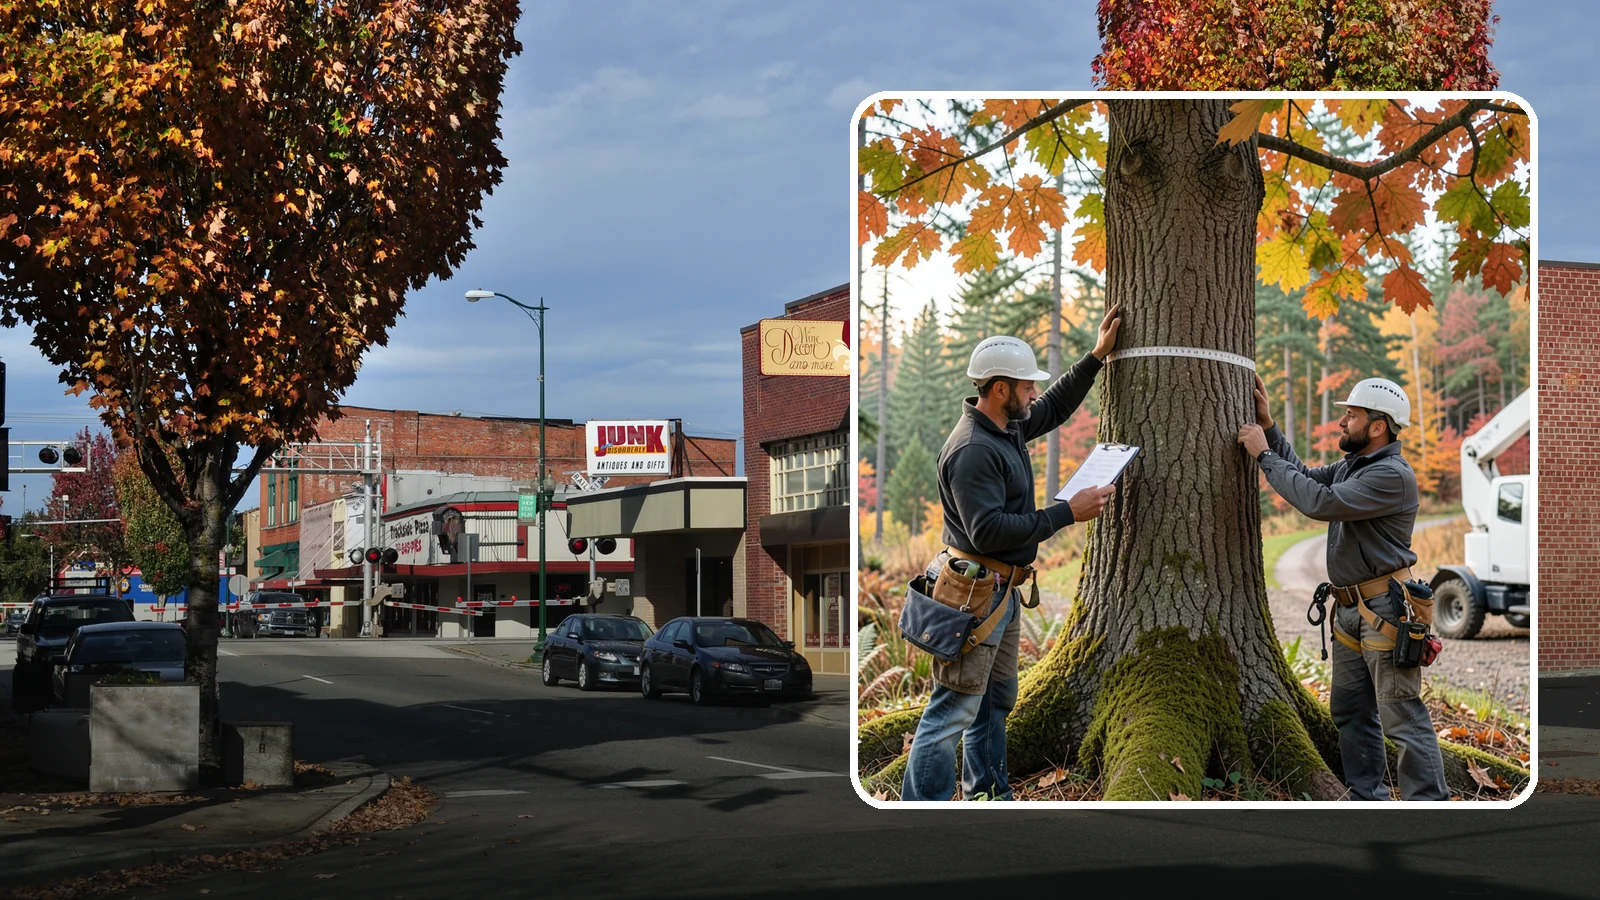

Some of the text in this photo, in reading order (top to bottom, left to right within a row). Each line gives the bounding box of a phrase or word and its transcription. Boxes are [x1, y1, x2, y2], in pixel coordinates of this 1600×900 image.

[596, 425, 664, 457] JUNK
[607, 446, 646, 454] DISORDERLY
[597, 460, 665, 470] ANTIQUES AND GIFTS
[414, 519, 429, 535] Pizza
